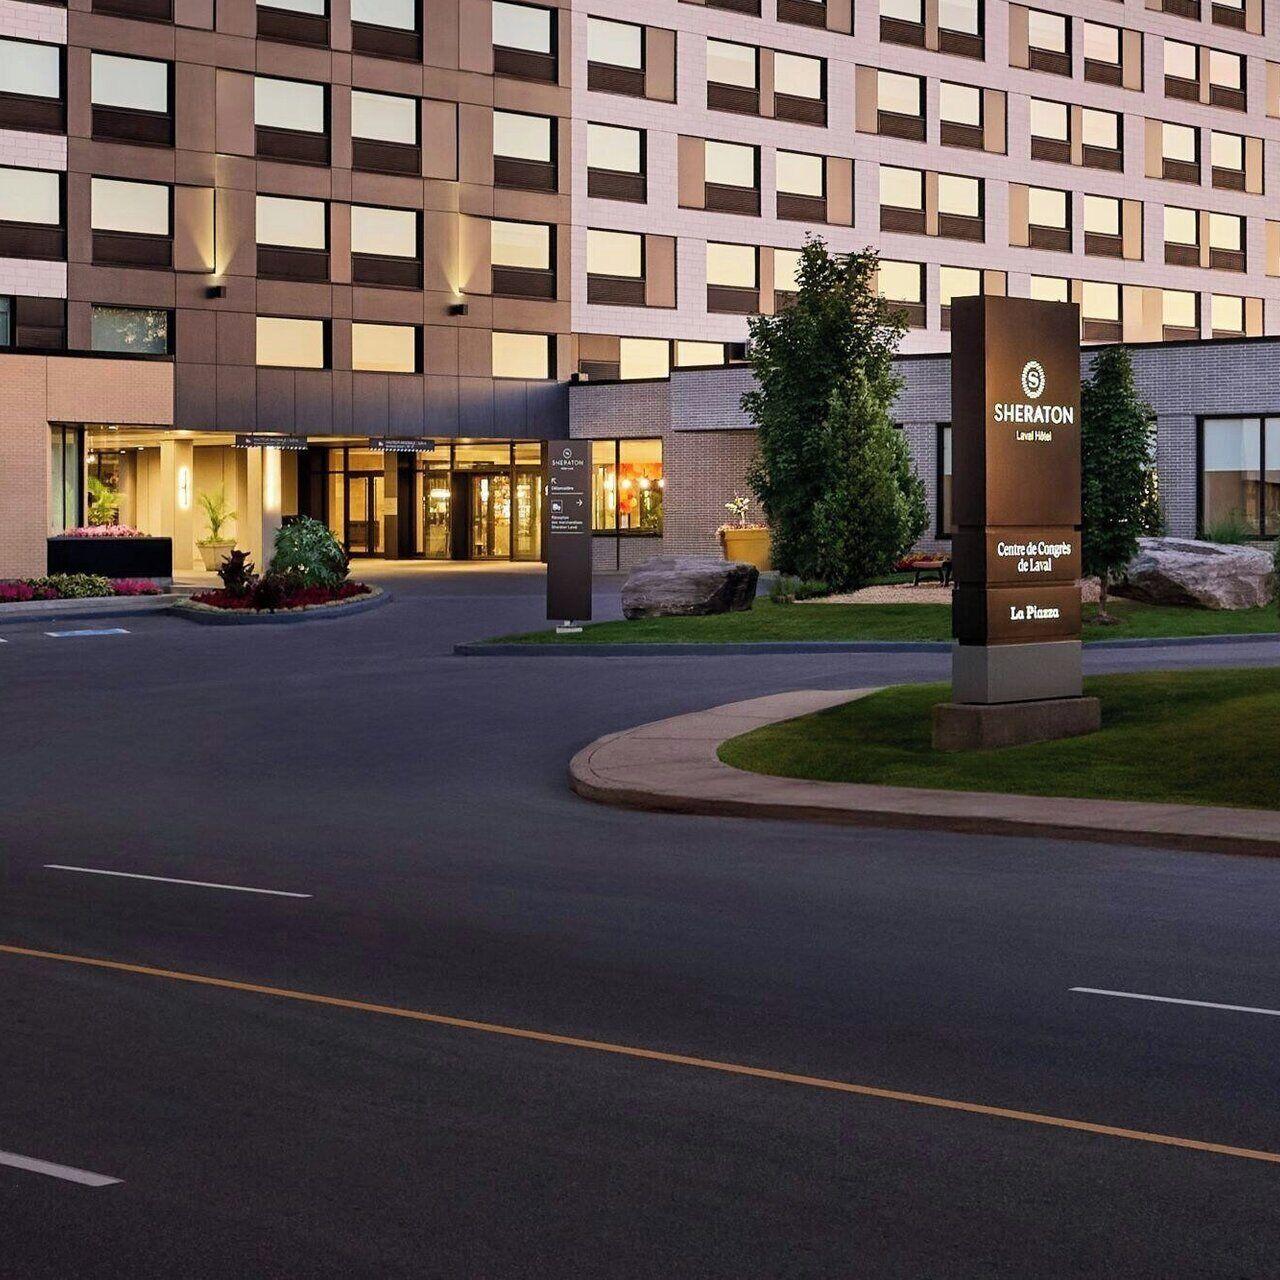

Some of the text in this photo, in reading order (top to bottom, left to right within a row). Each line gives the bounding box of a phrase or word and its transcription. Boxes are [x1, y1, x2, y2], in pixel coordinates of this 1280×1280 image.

[1027, 371, 1040, 389] S
[993, 403, 1074, 425] SHERATON
[1016, 430, 1034, 441] Laval
[997, 541, 1072, 559] Centre de Congrès
[1017, 558, 1052, 573] de Laval
[1010, 605, 1060, 621] La Piazza
